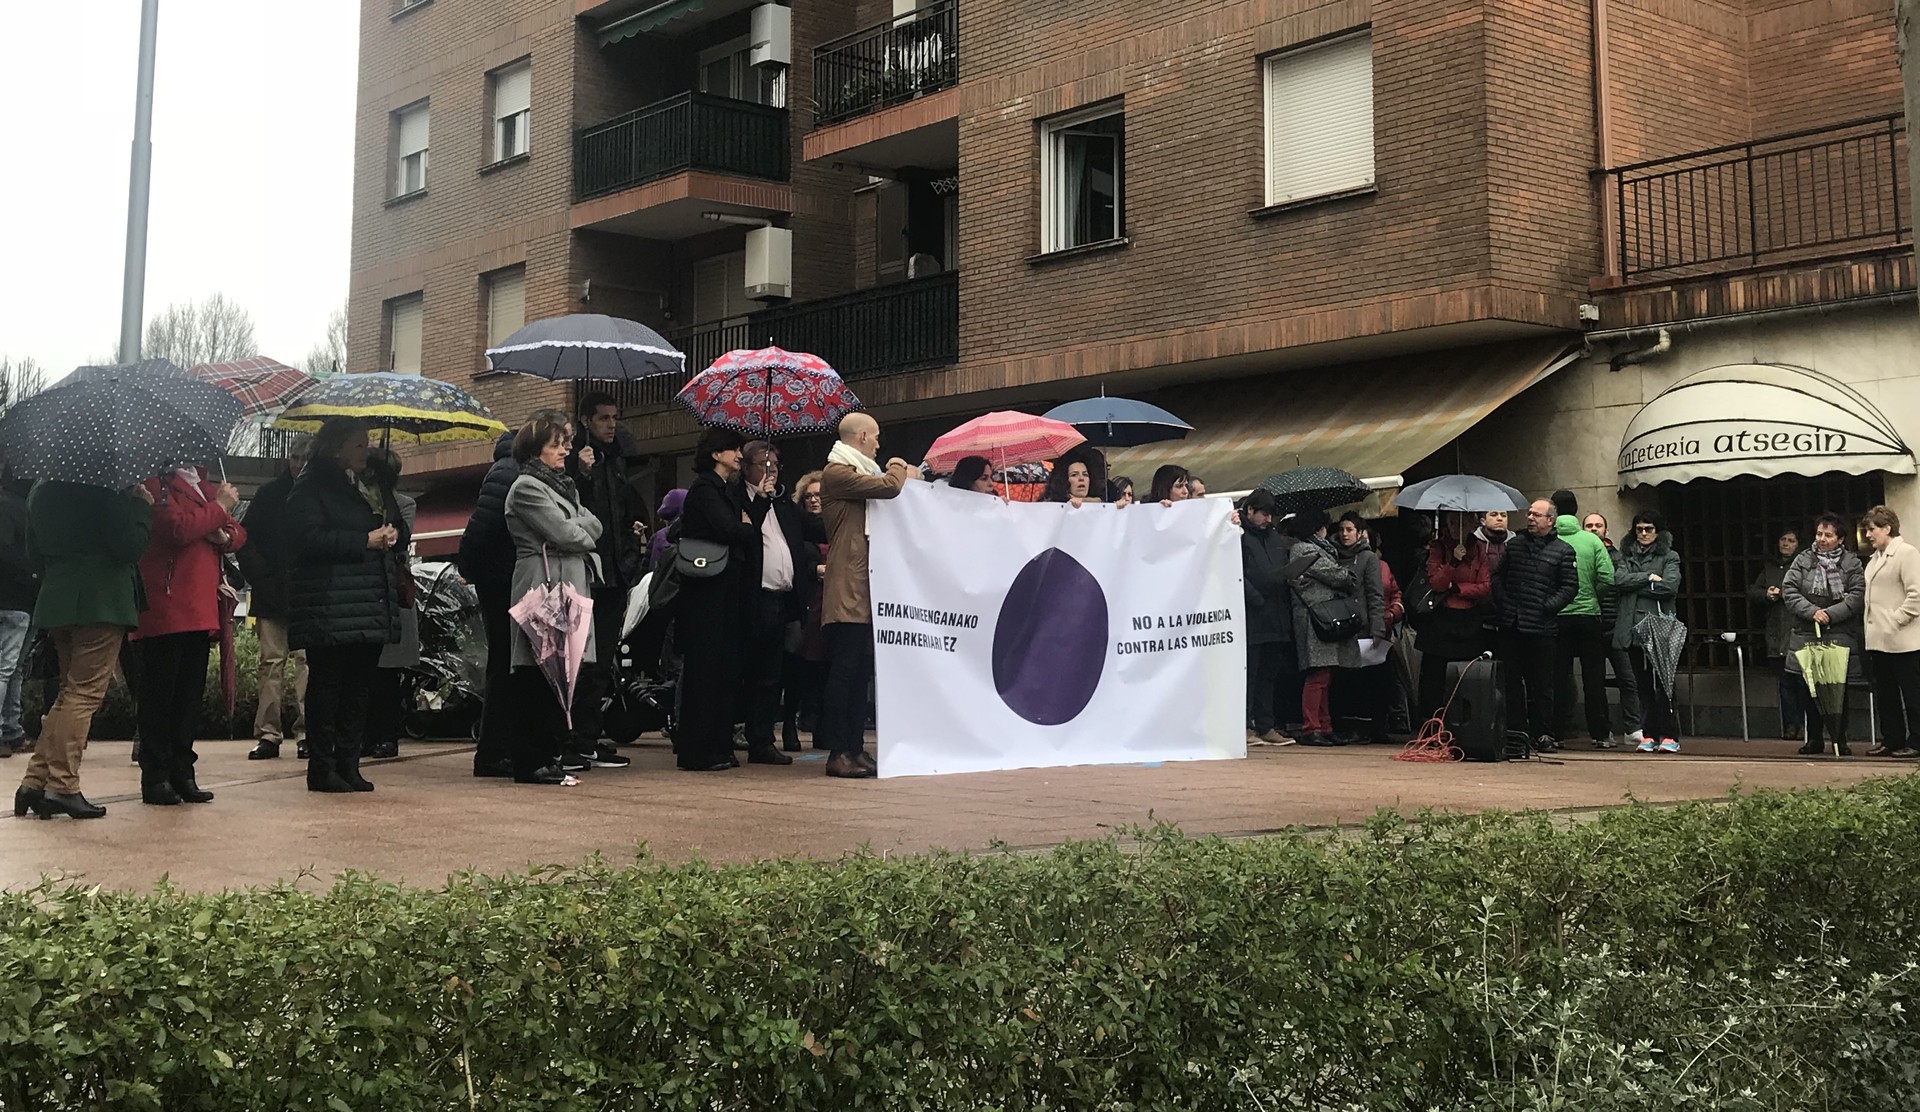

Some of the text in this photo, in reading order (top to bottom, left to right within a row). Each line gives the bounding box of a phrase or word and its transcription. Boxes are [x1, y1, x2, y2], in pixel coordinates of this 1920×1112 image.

[877, 602, 979, 629] EMAKUMEENGANAKO
[1132, 608, 1232, 631] NO A LA VIOLENCIA
[877, 629, 958, 652] INDARKERIARI EZ
[1116, 630, 1234, 655] CONTRA LAS MUJERES
